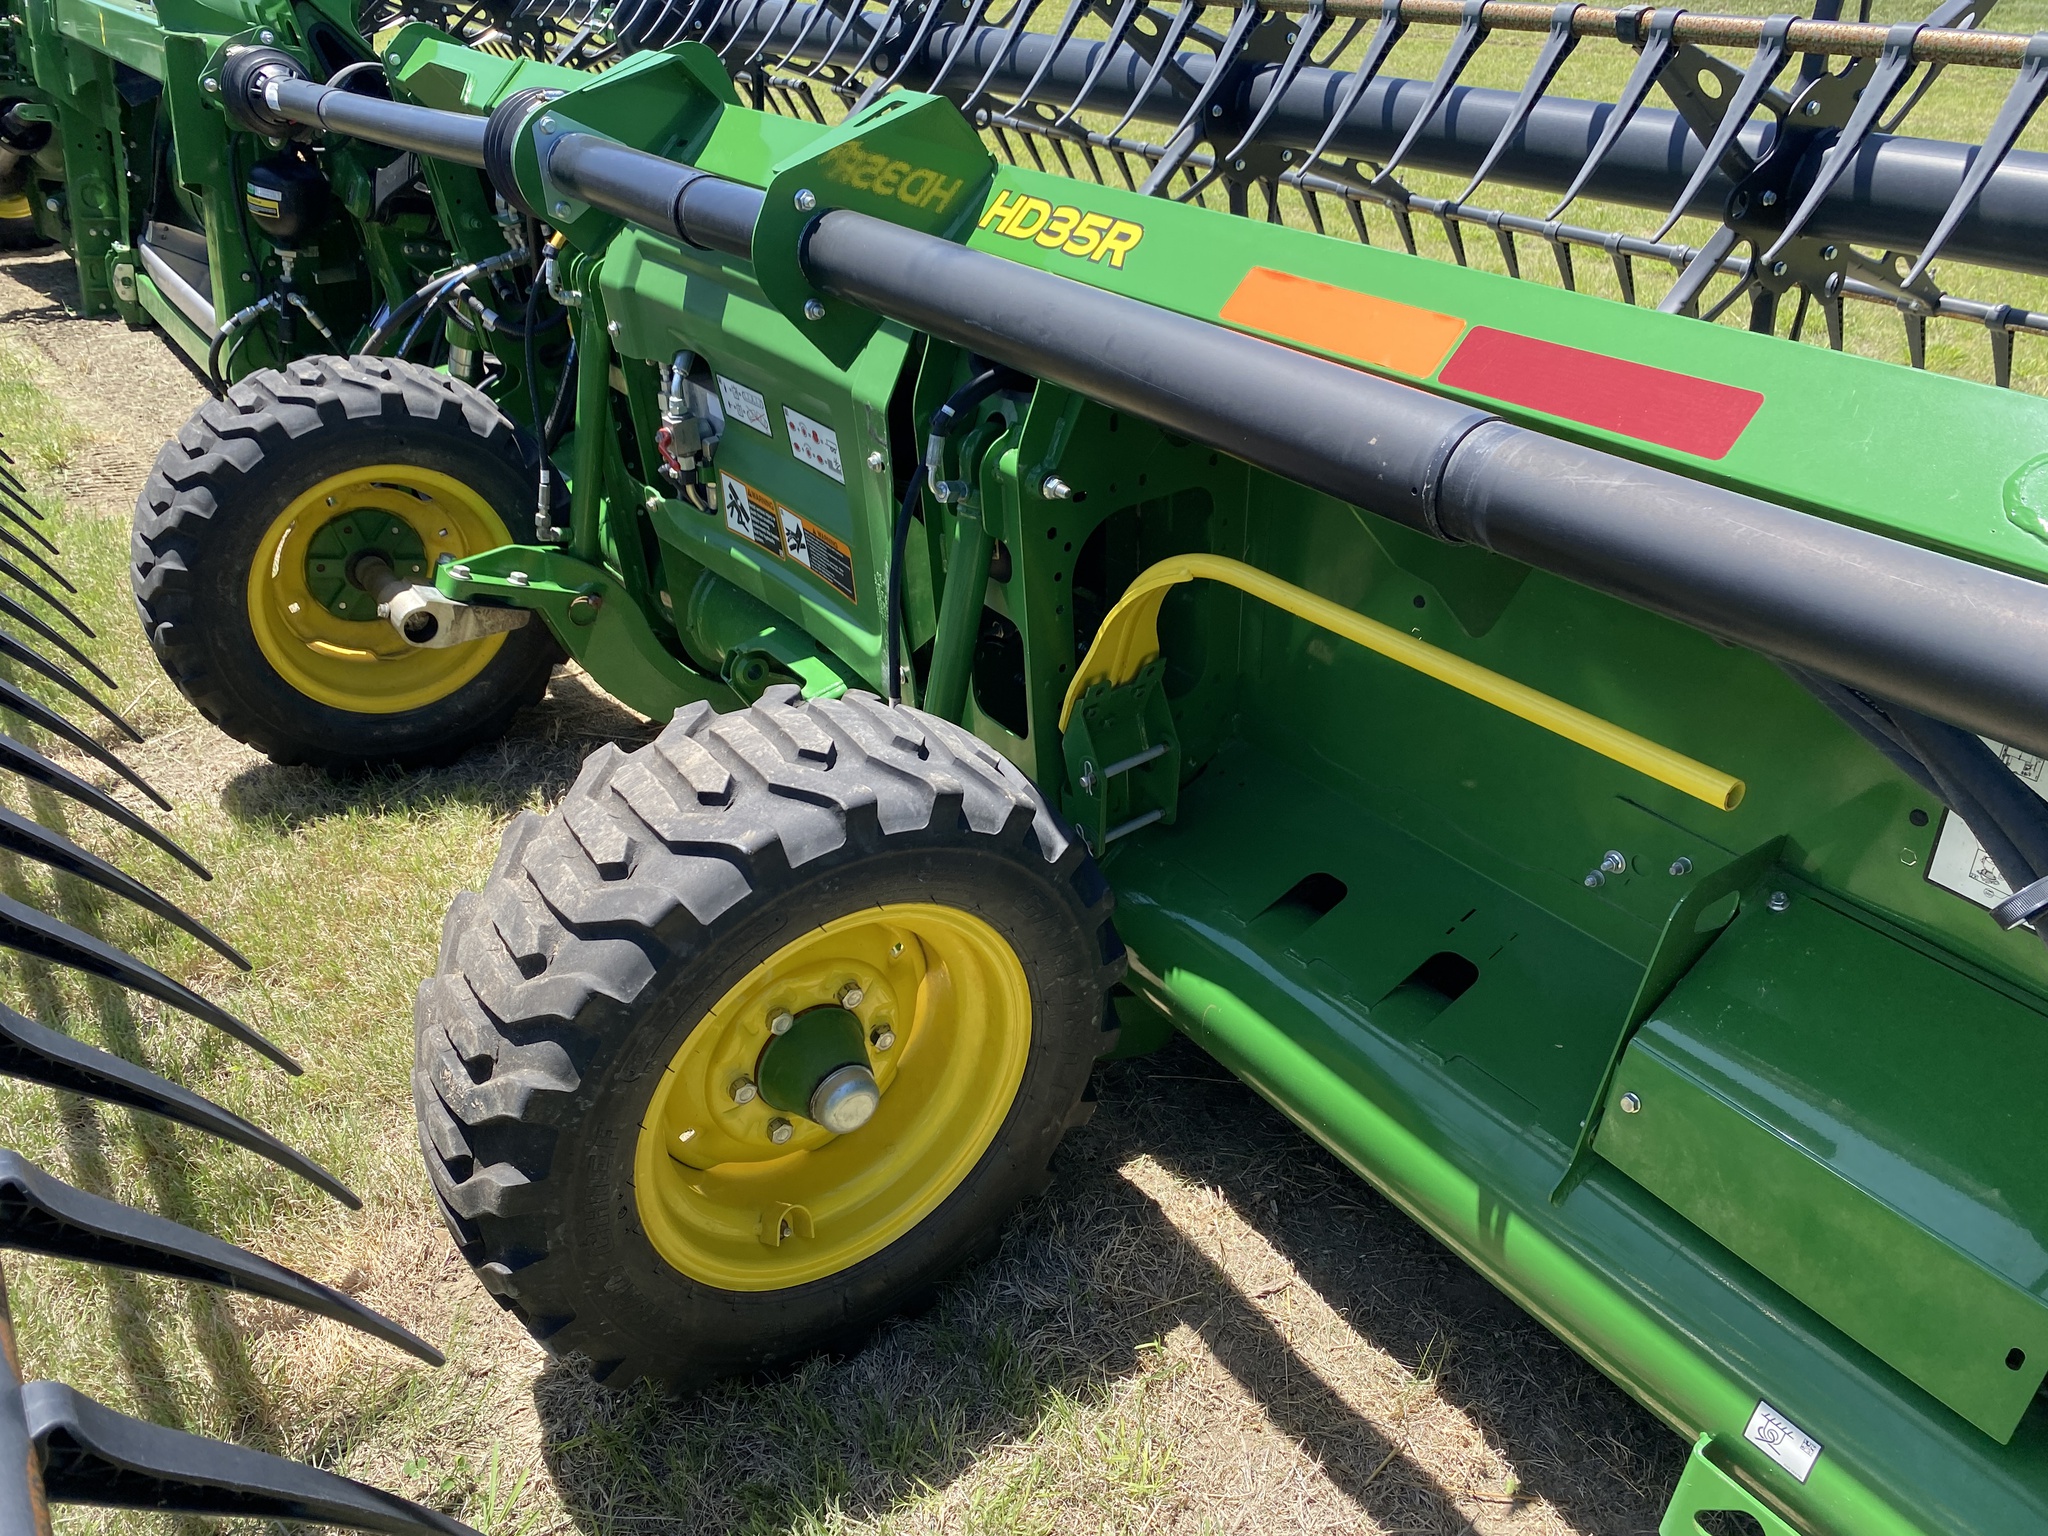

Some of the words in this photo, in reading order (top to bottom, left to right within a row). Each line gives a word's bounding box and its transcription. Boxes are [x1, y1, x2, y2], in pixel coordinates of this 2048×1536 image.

[979, 189, 1145, 271] HD35R
[751, 489, 775, 511] WARNING
[817, 528, 839, 550] WARNING
[583, 1125, 620, 1260] CHIEF
